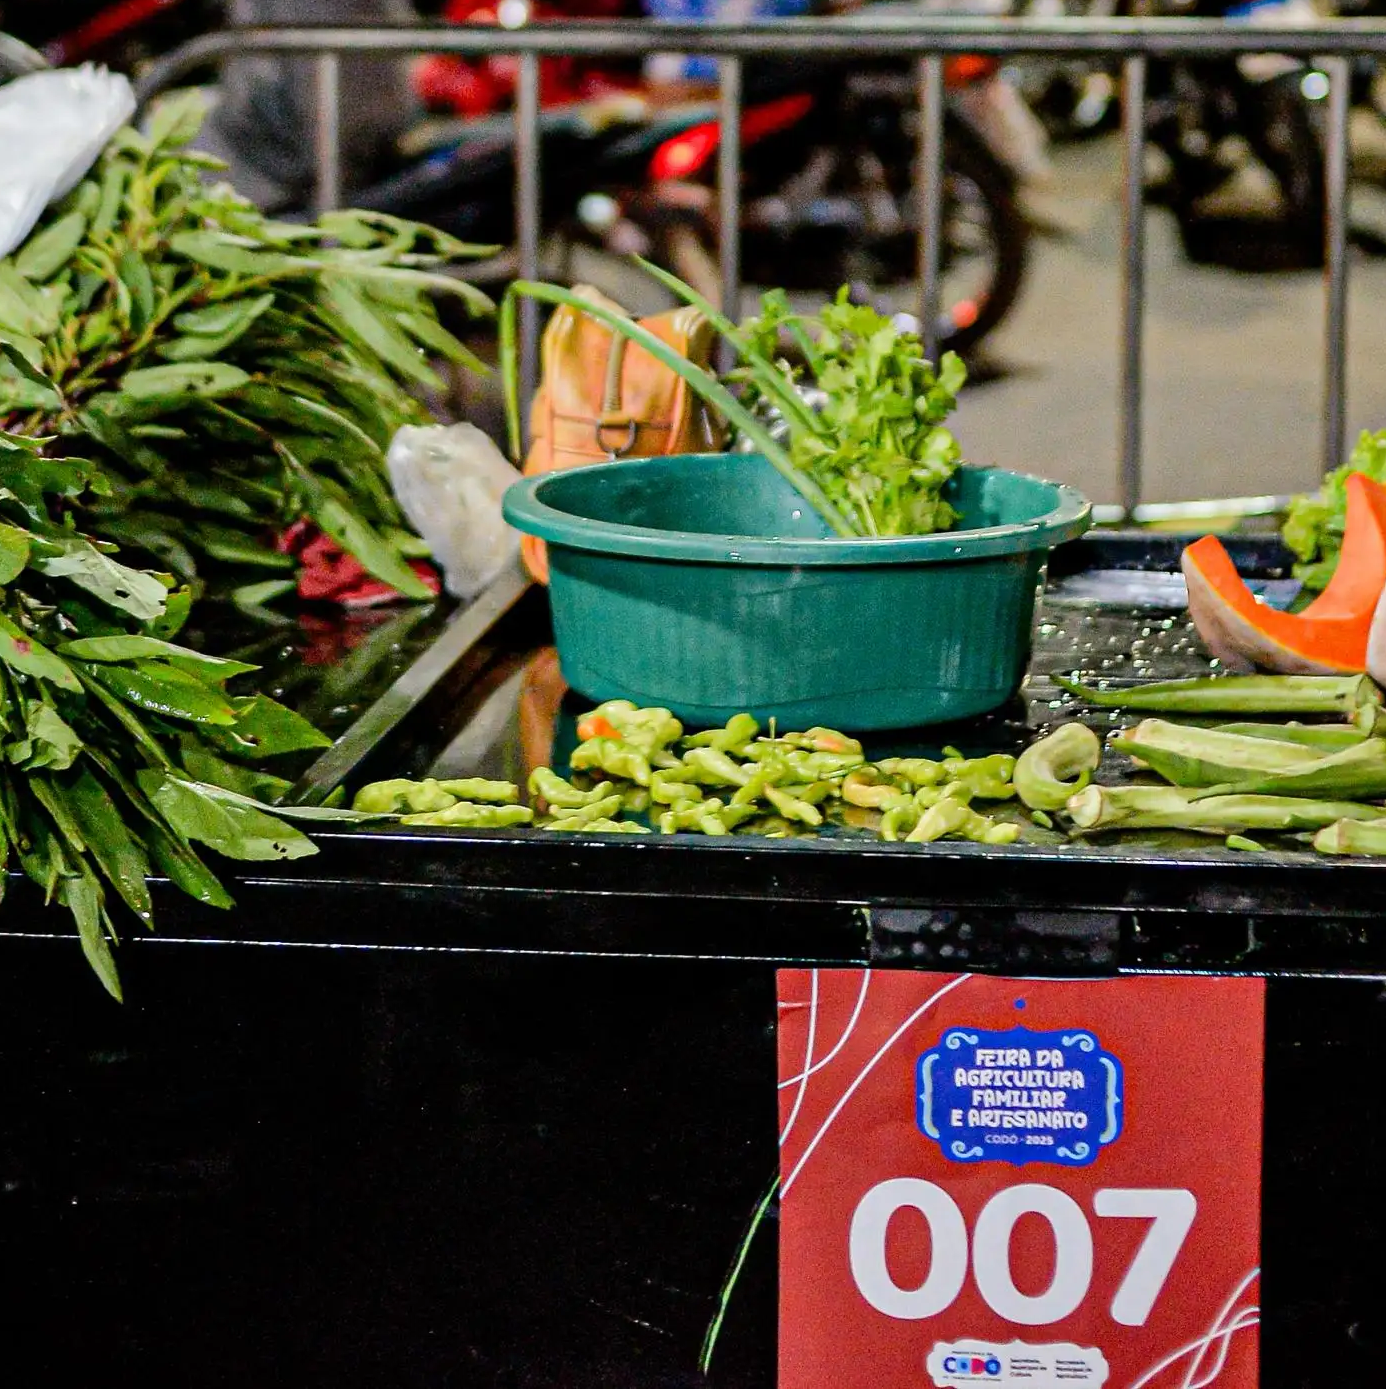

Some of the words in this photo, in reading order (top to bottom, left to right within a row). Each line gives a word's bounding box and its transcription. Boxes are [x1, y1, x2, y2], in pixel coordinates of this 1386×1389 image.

[975, 1048, 1031, 1067] FEIRA
[1036, 1049, 1064, 1068] DA
[954, 1068, 1085, 1089] AGRICULTURA
[972, 1089, 1067, 1108] FAMILIAR
[951, 1109, 963, 1127] E
[967, 1109, 1088, 1129] ARTESANATO
[849, 1177, 1197, 1326] 007
